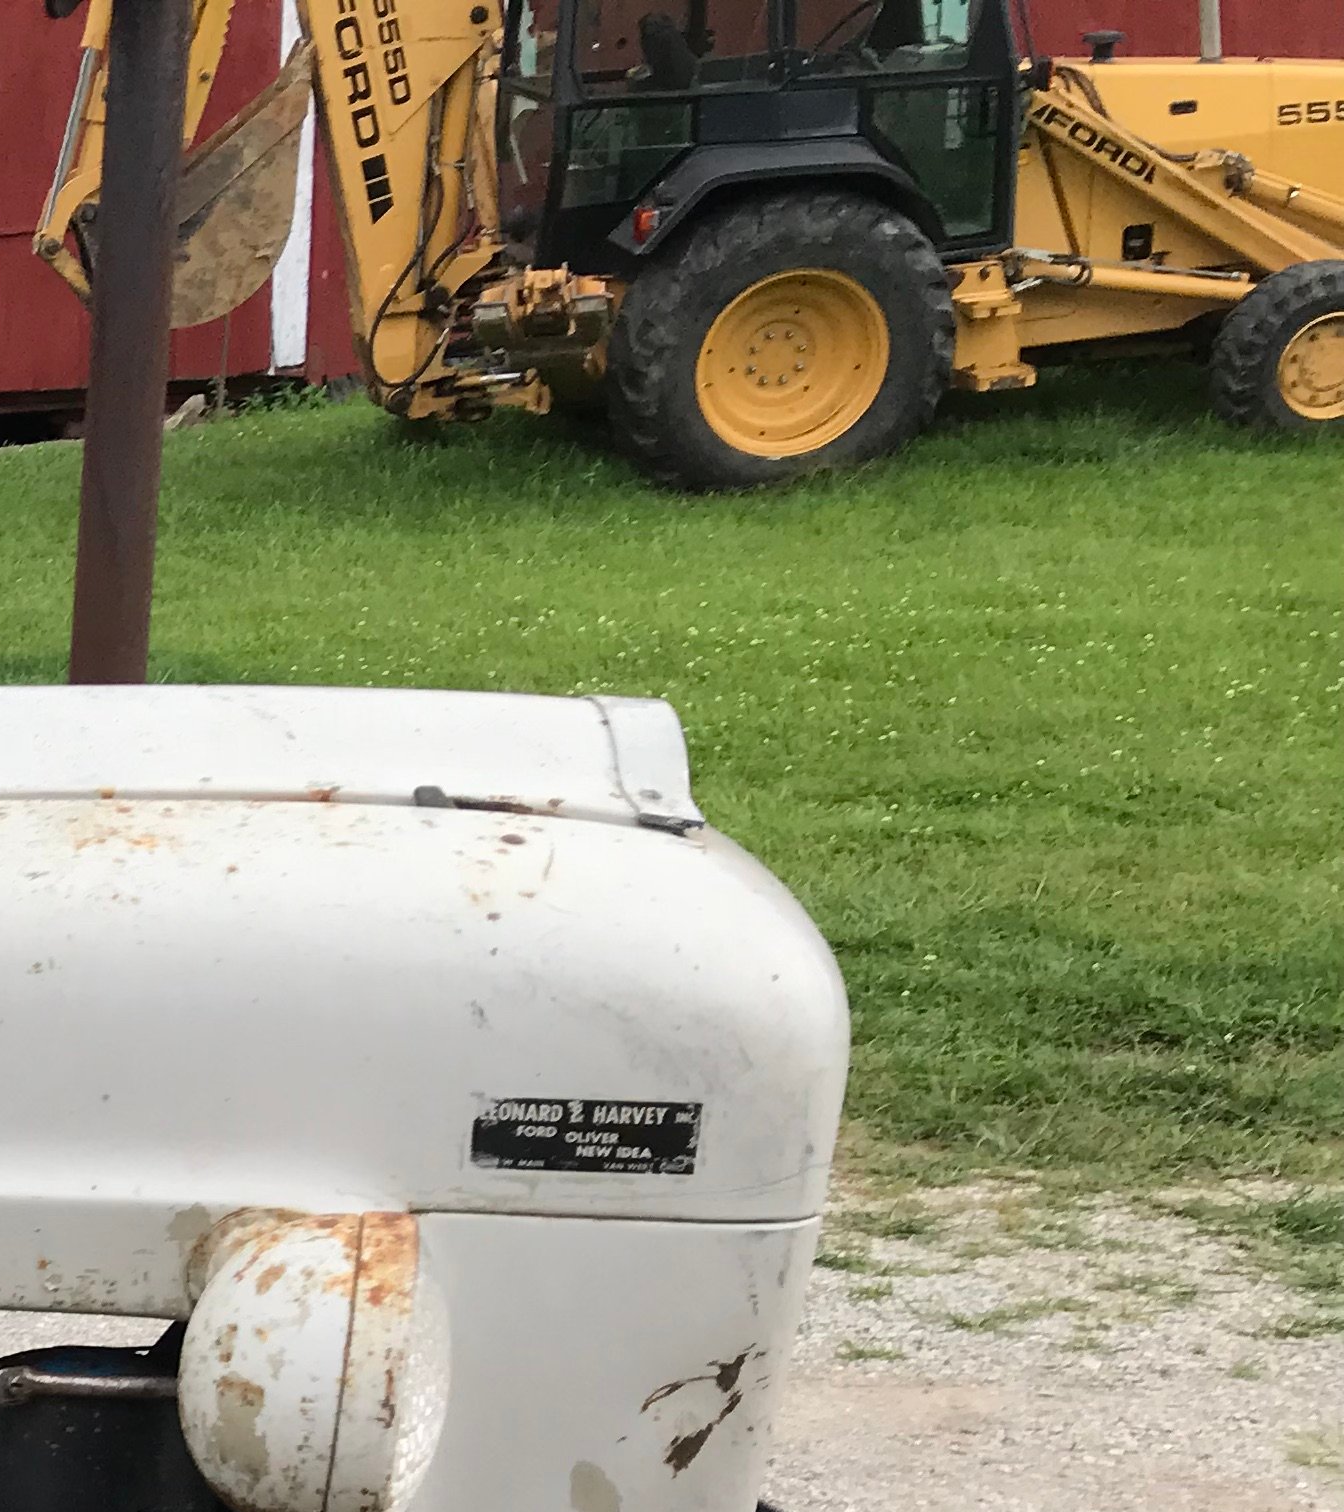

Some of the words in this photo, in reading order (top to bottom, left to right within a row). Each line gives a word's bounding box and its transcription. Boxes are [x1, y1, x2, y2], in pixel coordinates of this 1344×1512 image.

[1044, 103, 1150, 178] FORD
[482, 1102, 563, 1122] ONARD
[593, 1105, 670, 1125] HARVEY
[515, 1125, 558, 1138] FORD
[564, 1131, 620, 1145] OLIVER
[575, 1145, 614, 1159] NEW
[615, 1146, 653, 1160] IDEA
